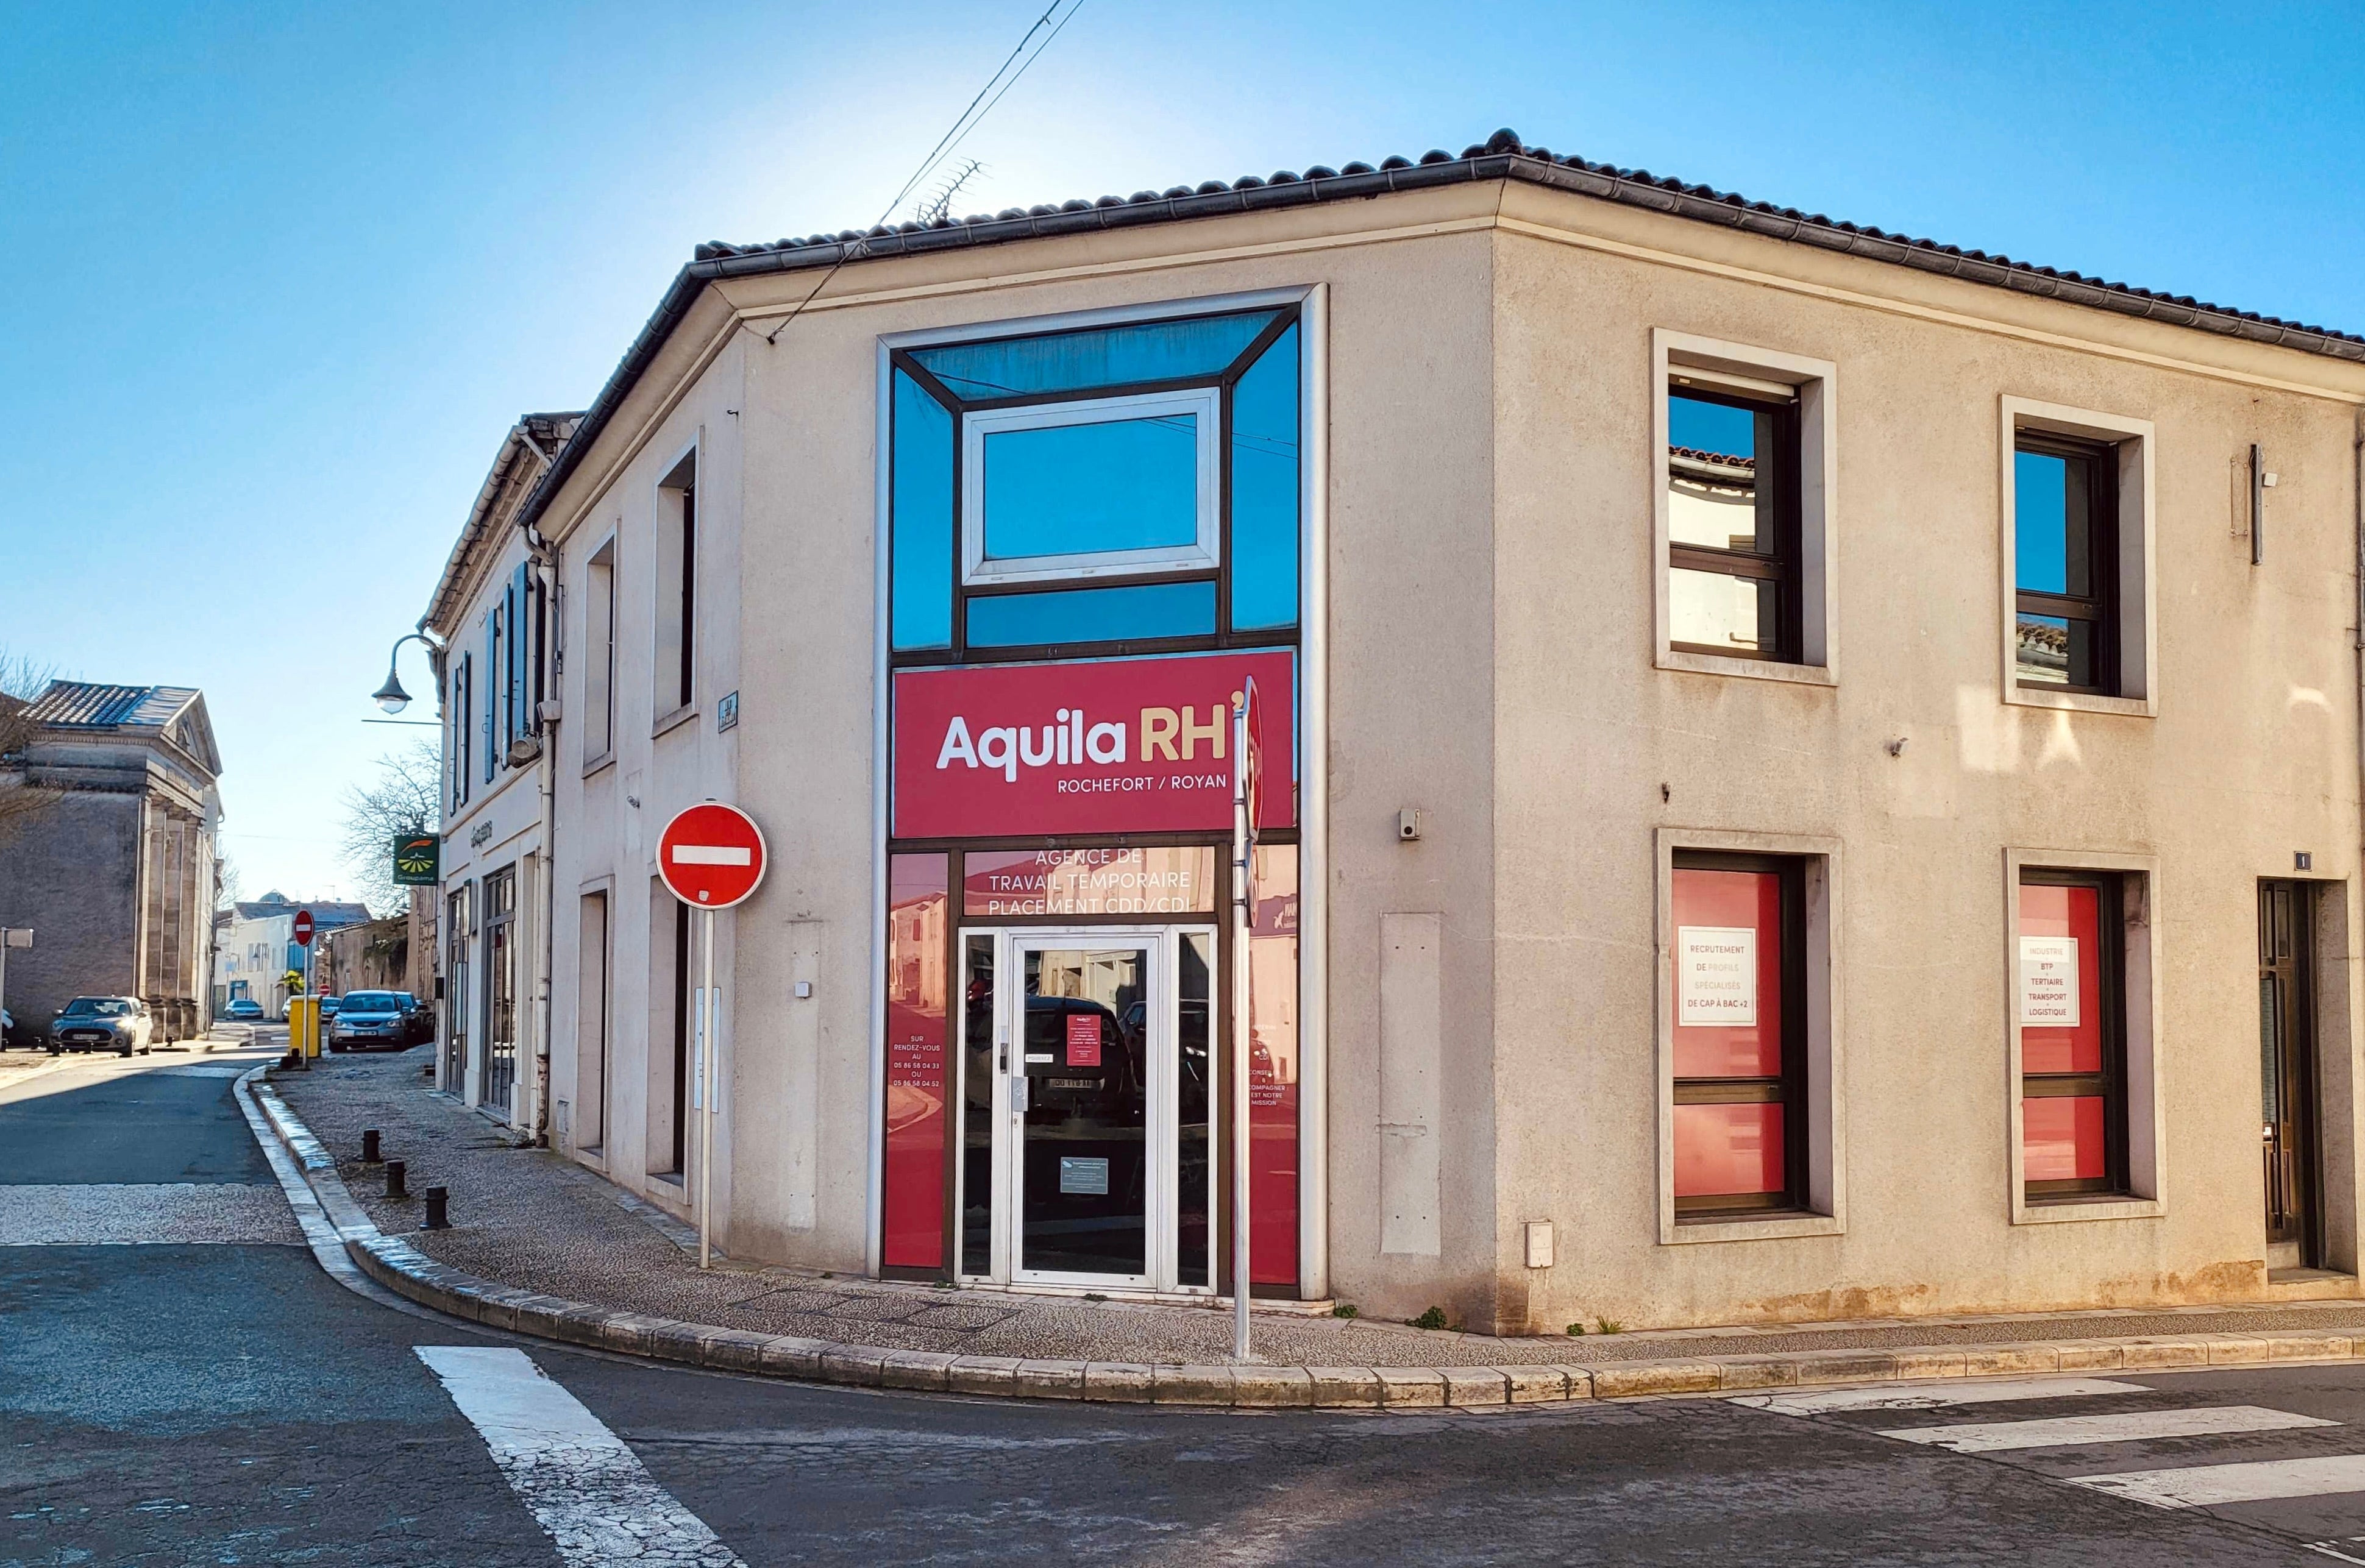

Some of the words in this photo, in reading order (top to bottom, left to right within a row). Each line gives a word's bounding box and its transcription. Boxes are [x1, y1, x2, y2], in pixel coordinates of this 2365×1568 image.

[936, 708, 1126, 782] Aquila
[1058, 776, 1154, 793] ROCHEFORT
[1158, 776, 1166, 790] /
[1172, 774, 1226, 790] ROYAN
[1036, 849, 1111, 865] AGENCE
[1118, 848, 1142, 864] DE
[2301, 856, 2305, 867] 1
[989, 874, 1061, 891] TRAVAIL
[1068, 871, 1190, 889] TEMPORAIRE
[989, 898, 1101, 915] PLACEMENT
[1106, 896, 1190, 913] CDD/CDI
[1690, 945, 1745, 954] RECRUTEMENT
[1724, 999, 1738, 1008] BAC
